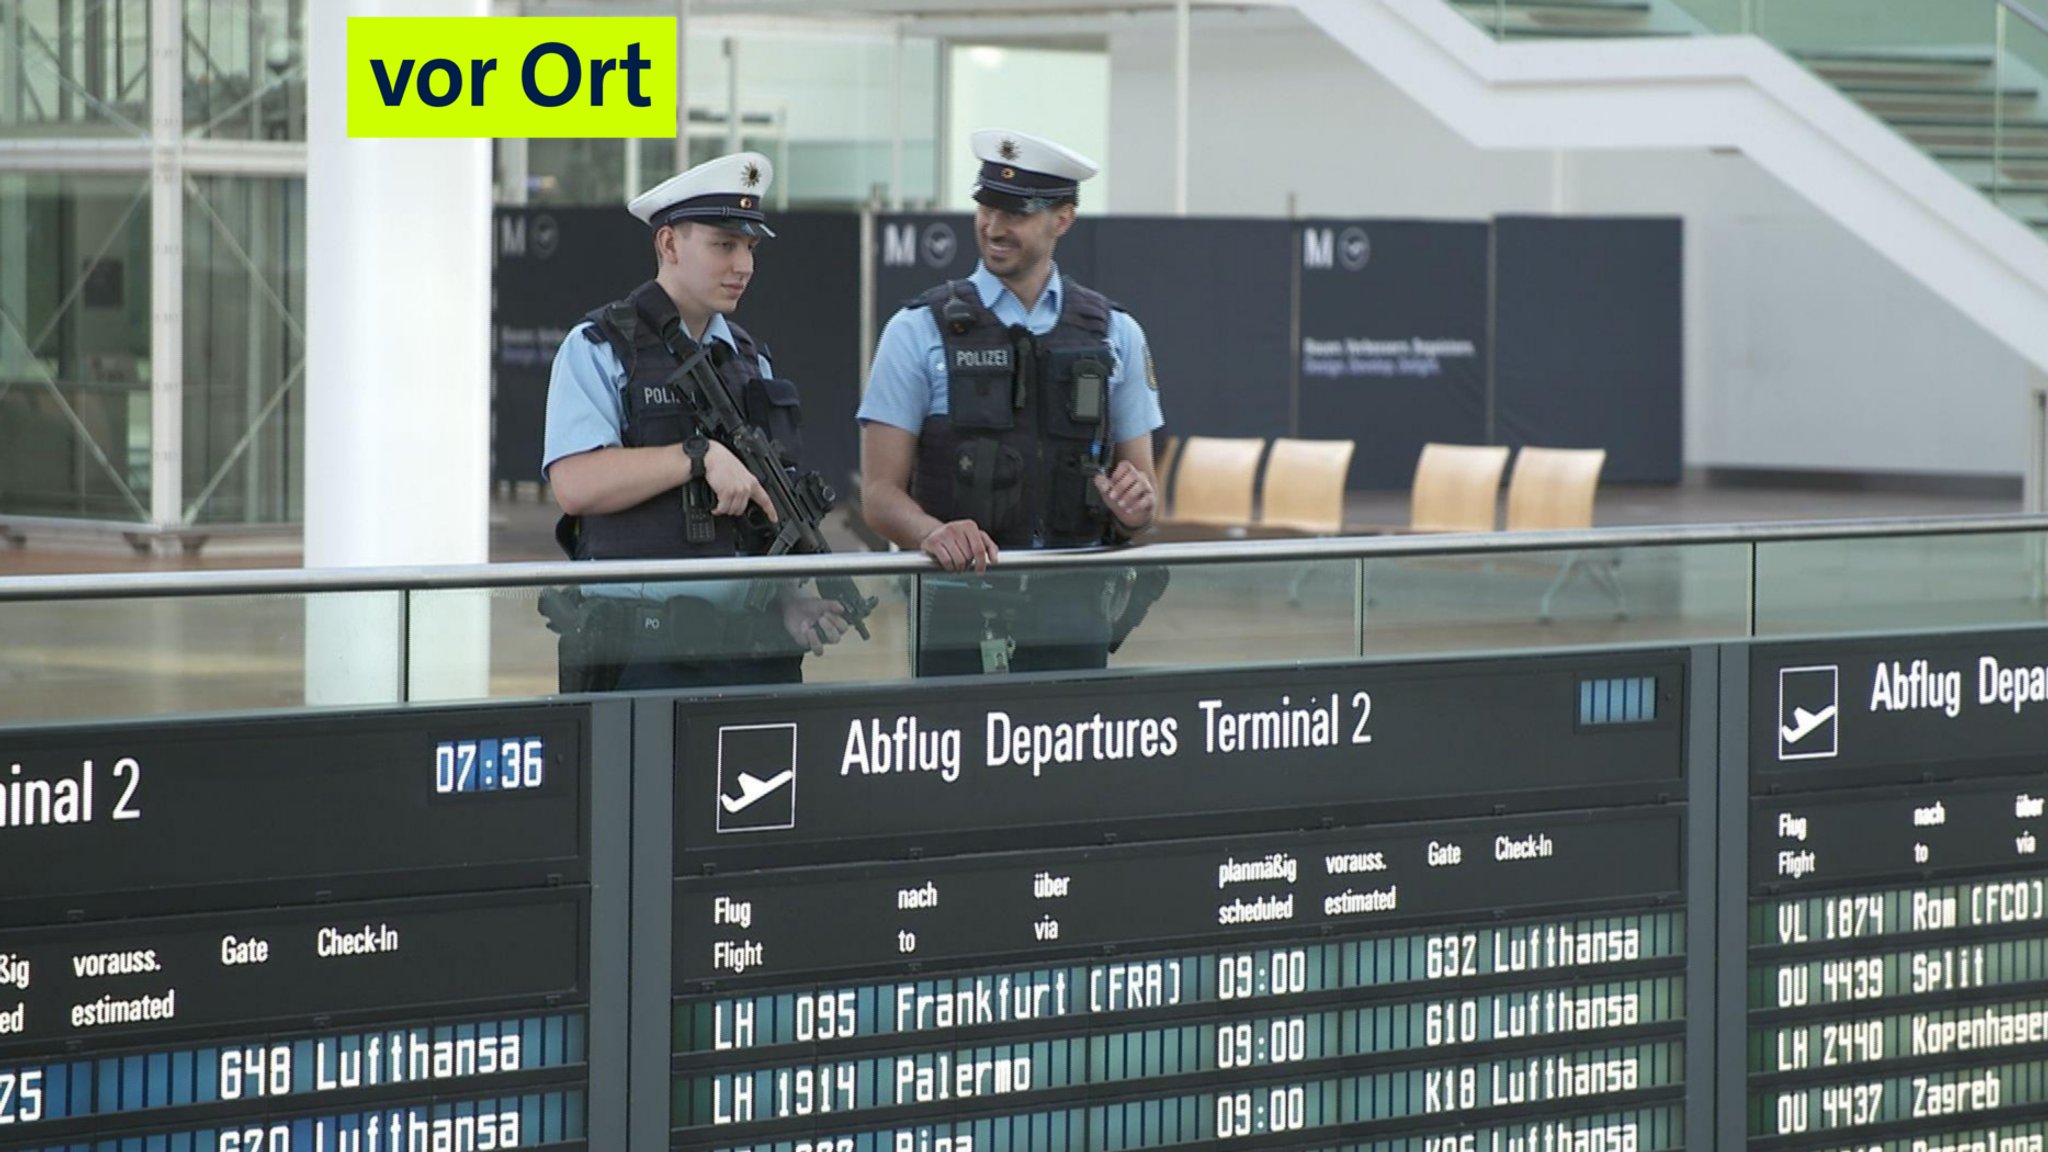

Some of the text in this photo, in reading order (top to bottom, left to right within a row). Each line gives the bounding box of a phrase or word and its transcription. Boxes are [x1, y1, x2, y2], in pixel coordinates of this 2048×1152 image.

[883, 224, 916, 266] M
[1303, 227, 1334, 269] M
[957, 350, 1008, 366] POLIZEI
[644, 386, 697, 404] POLII
[645, 617, 661, 630] PO
[1870, 656, 2048, 717] Abflug Depa
[840, 692, 1372, 782] Abflug Departures Terminal 2
[0, 758, 140, 827] inal 2
[436, 741, 542, 793] 07:36
[1778, 794, 2044, 841] Flug nach über
[1219, 834, 1552, 889] planmäßig vorauss. Gate Check-In
[1778, 831, 2036, 878] Flight to via
[714, 872, 1070, 928] Flug nach über
[1218, 885, 1396, 924] scheduled estimated
[1778, 903, 1808, 944] VL
[1826, 895, 1884, 939] 1874
[1913, 891, 1956, 931] Rom
[73, 950, 161, 977] vorauss.
[221, 935, 268, 965] Gate
[318, 924, 398, 957] Check-In
[714, 914, 1059, 973] Flight to via
[715, 1001, 754, 1050] LH
[796, 992, 855, 1041] 095
[897, 972, 1066, 1032] Frankfurt
[1219, 950, 1305, 1000] 09:00
[1494, 926, 1639, 973] Lufthansa
[1778, 947, 1983, 1008] OU 4439 Split
[71, 989, 175, 1026] estimated
[317, 1033, 520, 1091] Lufthansa
[714, 1075, 753, 1125] LH
[779, 1065, 855, 1117] 1914
[896, 1055, 1031, 1104] Palermo
[1218, 1018, 1304, 1069] 09:00
[1493, 991, 1638, 1039] Lufthansa
[1778, 1029, 1808, 1071] LH
[1823, 1020, 1883, 1066] 2440
[1217, 1057, 1638, 1138] 09:00 K18 Lufthansa
[1778, 1070, 2000, 1134] OU 4437 Zagreb
[316, 1111, 519, 1152] Lufthansa
